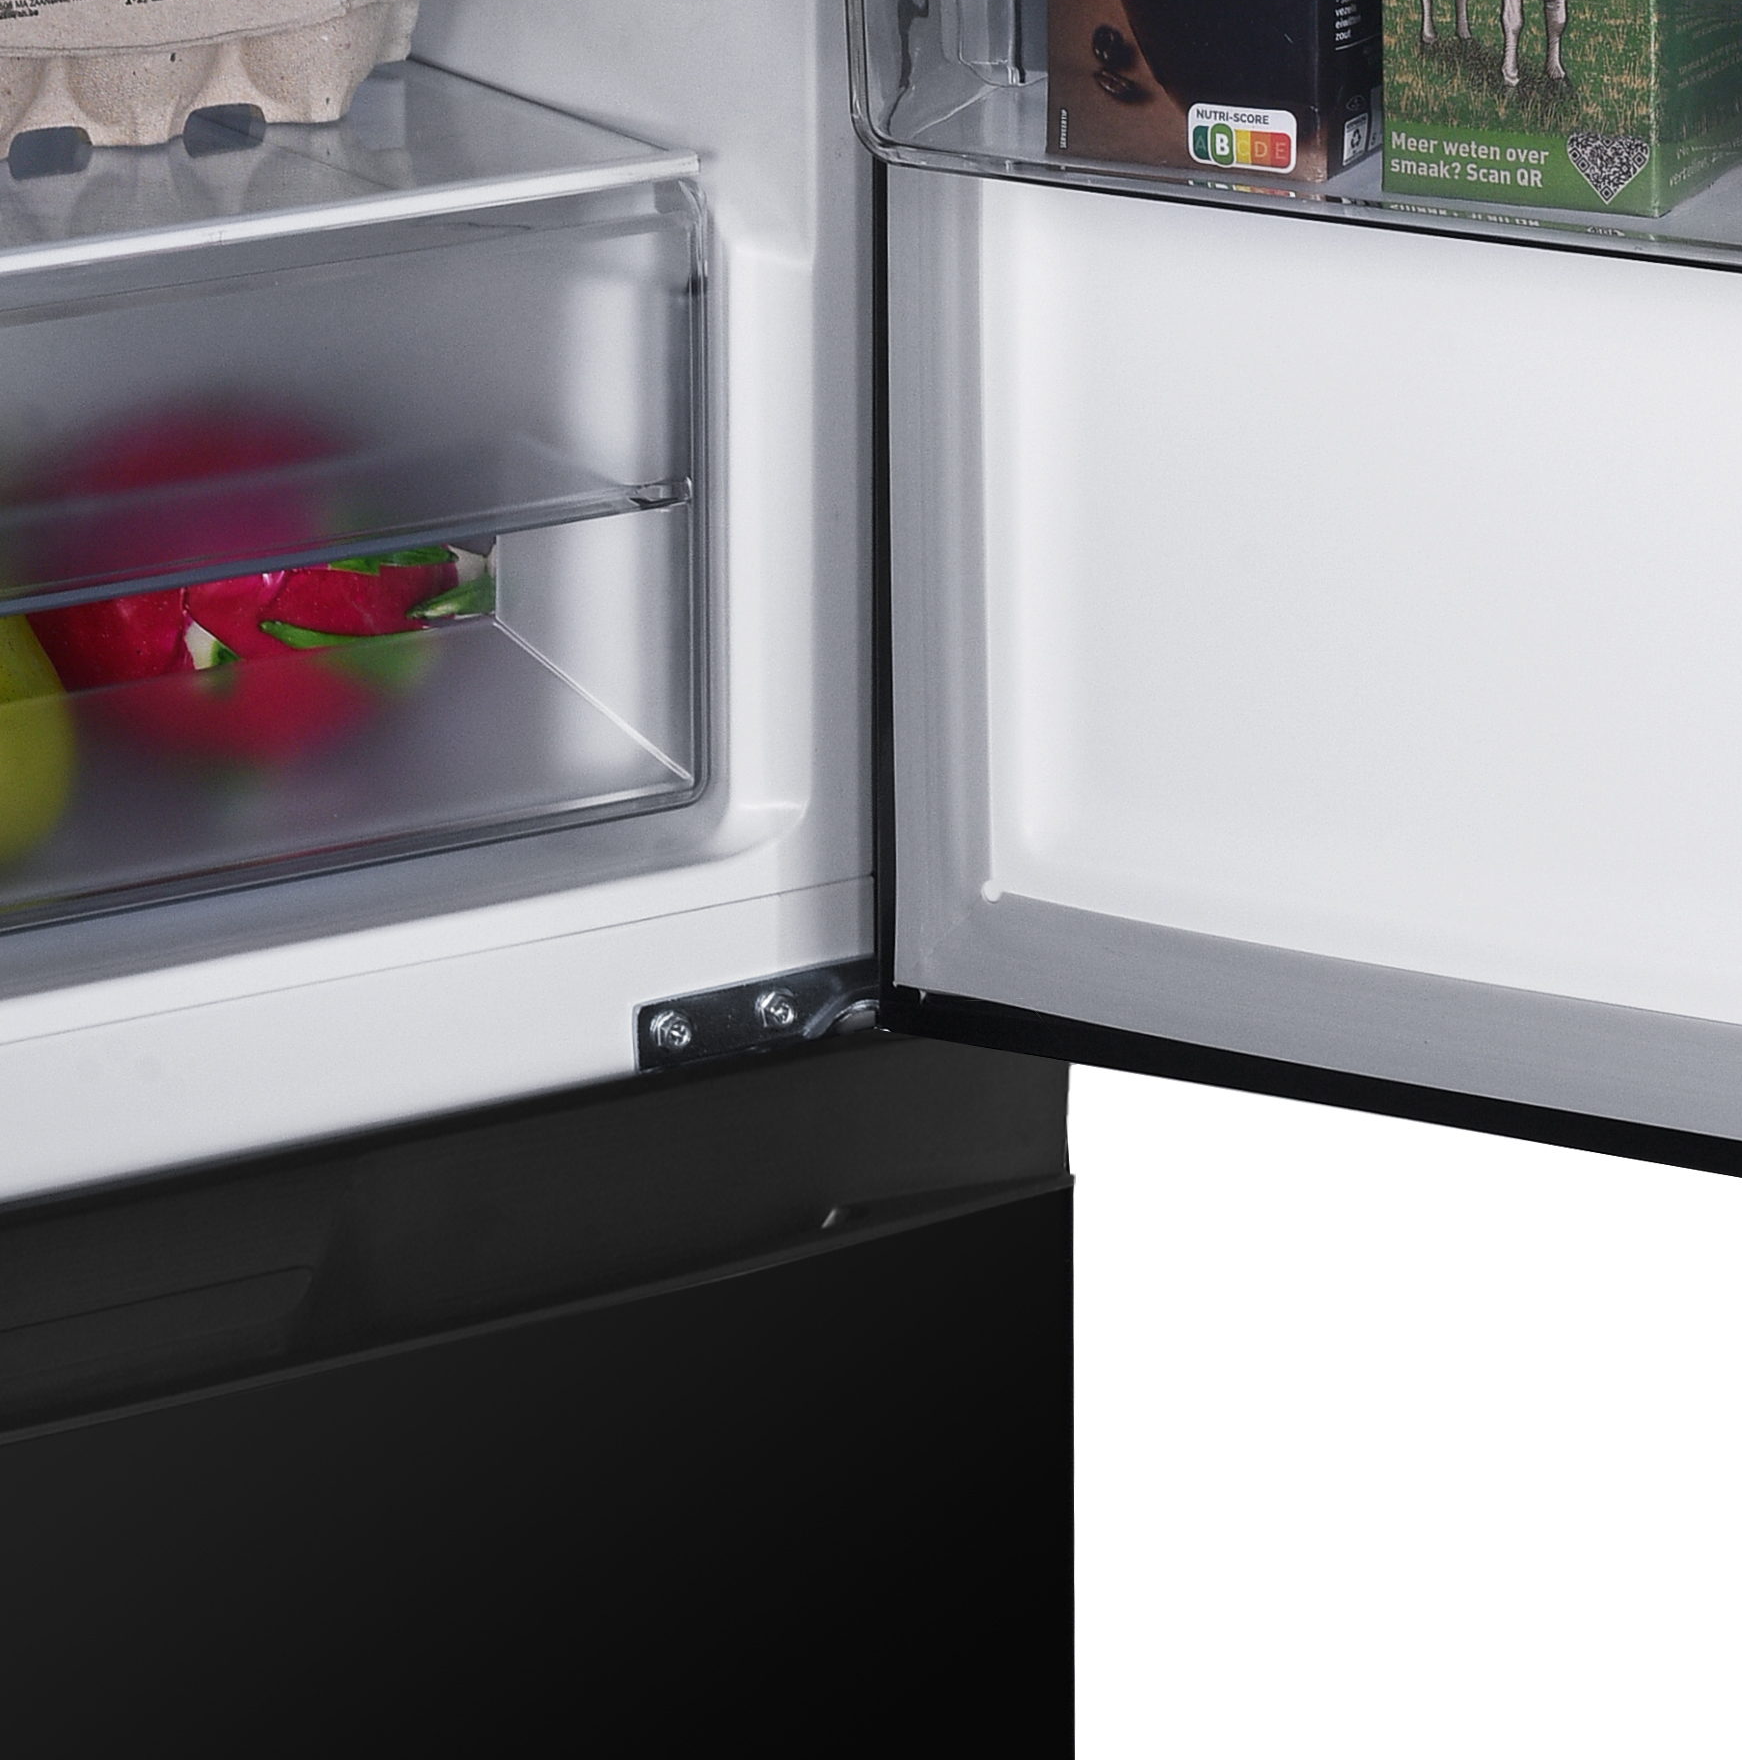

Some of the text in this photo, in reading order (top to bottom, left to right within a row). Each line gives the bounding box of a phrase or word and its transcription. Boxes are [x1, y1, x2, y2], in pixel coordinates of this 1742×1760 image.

[1196, 108, 1270, 126] NUTRI-SCORE
[1214, 132, 1231, 155] B
[1391, 132, 1438, 154] Meer
[1441, 138, 1501, 160] weten
[1506, 147, 1549, 165] over
[1390, 158, 1543, 189] smaak? Scan QR
